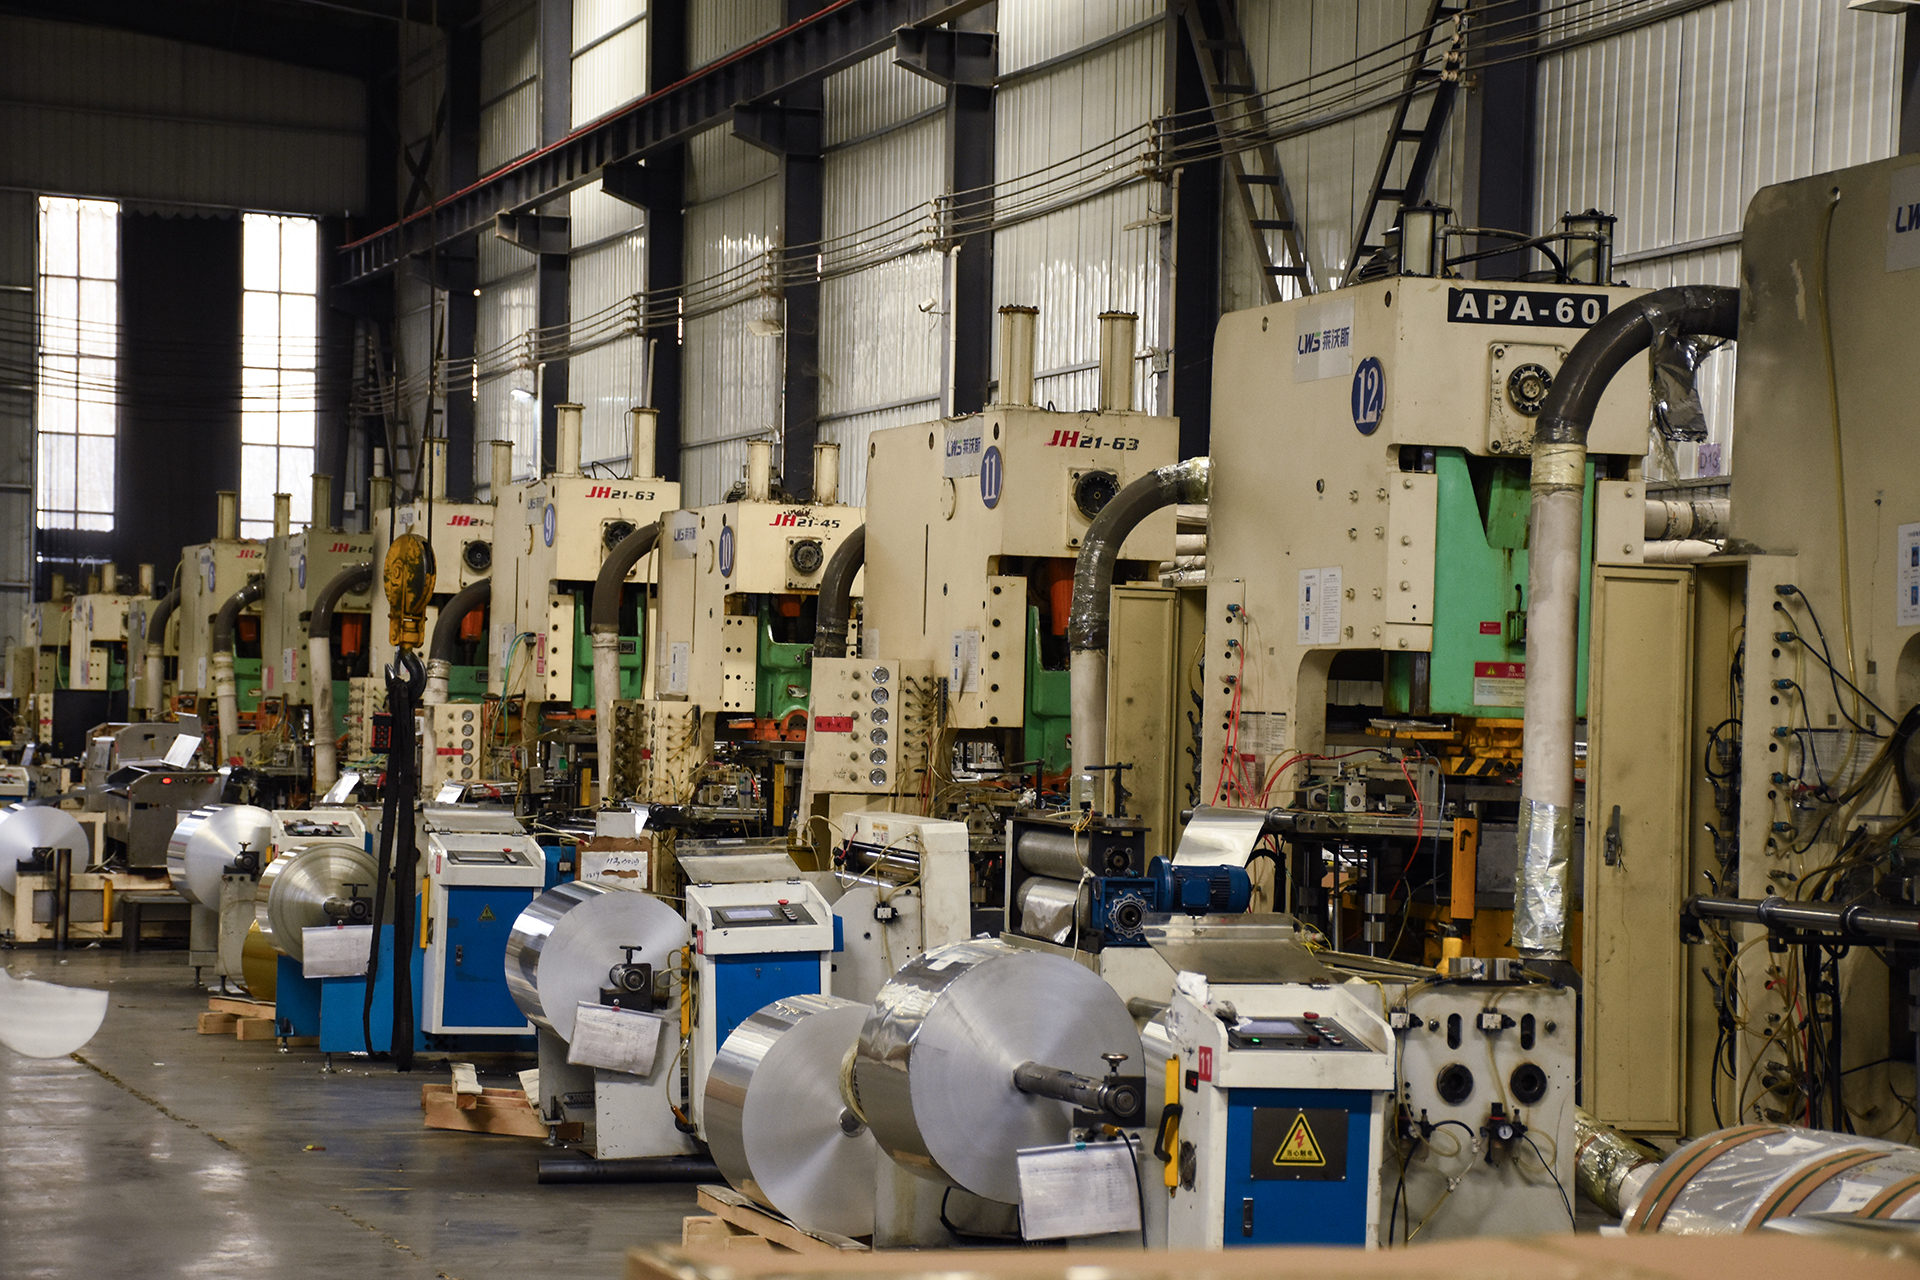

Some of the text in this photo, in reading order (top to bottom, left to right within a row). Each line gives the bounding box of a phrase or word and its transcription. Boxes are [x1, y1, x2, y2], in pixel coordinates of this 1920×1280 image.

[1456, 292, 1601, 325] APA-60
[1297, 325, 1350, 355] LWS 莱沃斯
[1355, 366, 1379, 424] 12
[1044, 430, 1140, 452] JH21-63
[984, 454, 997, 500] 11
[585, 486, 655, 501] JH21-63
[545, 508, 552, 542] 9
[769, 513, 841, 529] JH21-45
[721, 532, 731, 570] 10
[1200, 1052, 1211, 1076] 11
